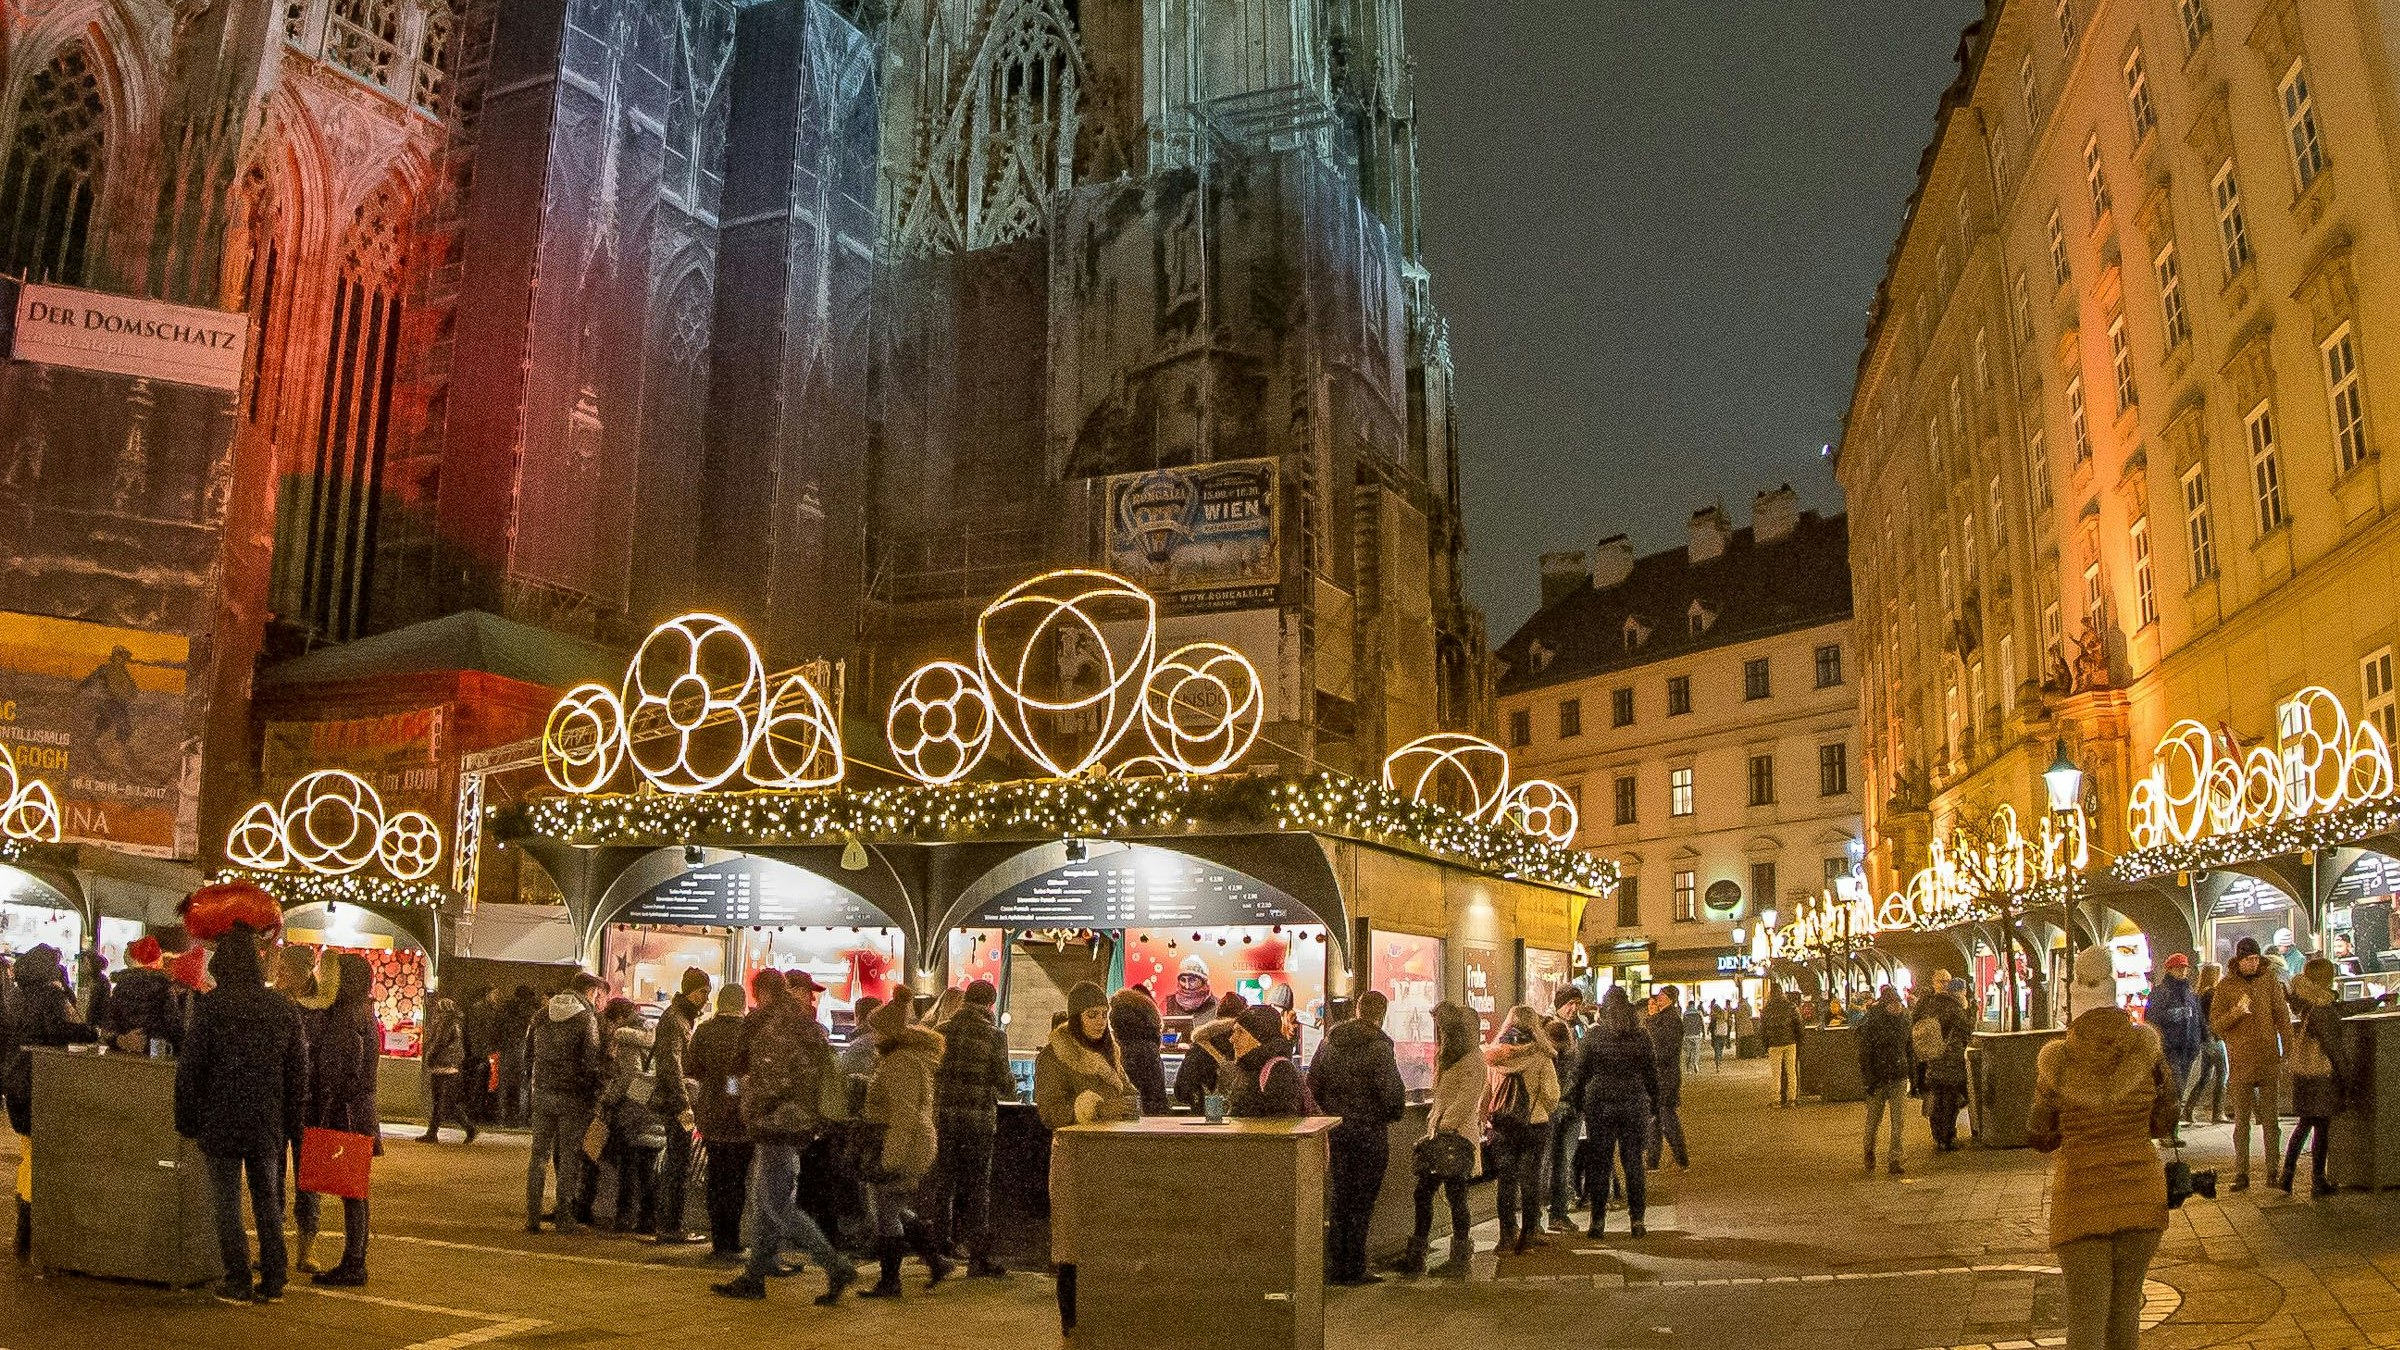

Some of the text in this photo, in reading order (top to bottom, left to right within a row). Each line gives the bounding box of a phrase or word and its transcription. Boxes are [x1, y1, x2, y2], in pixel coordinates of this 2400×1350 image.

[28, 301, 237, 351] DER DOMSCHATZ
[1203, 499, 1259, 521] WIEN
[16, 745, 69, 770] GOGH
